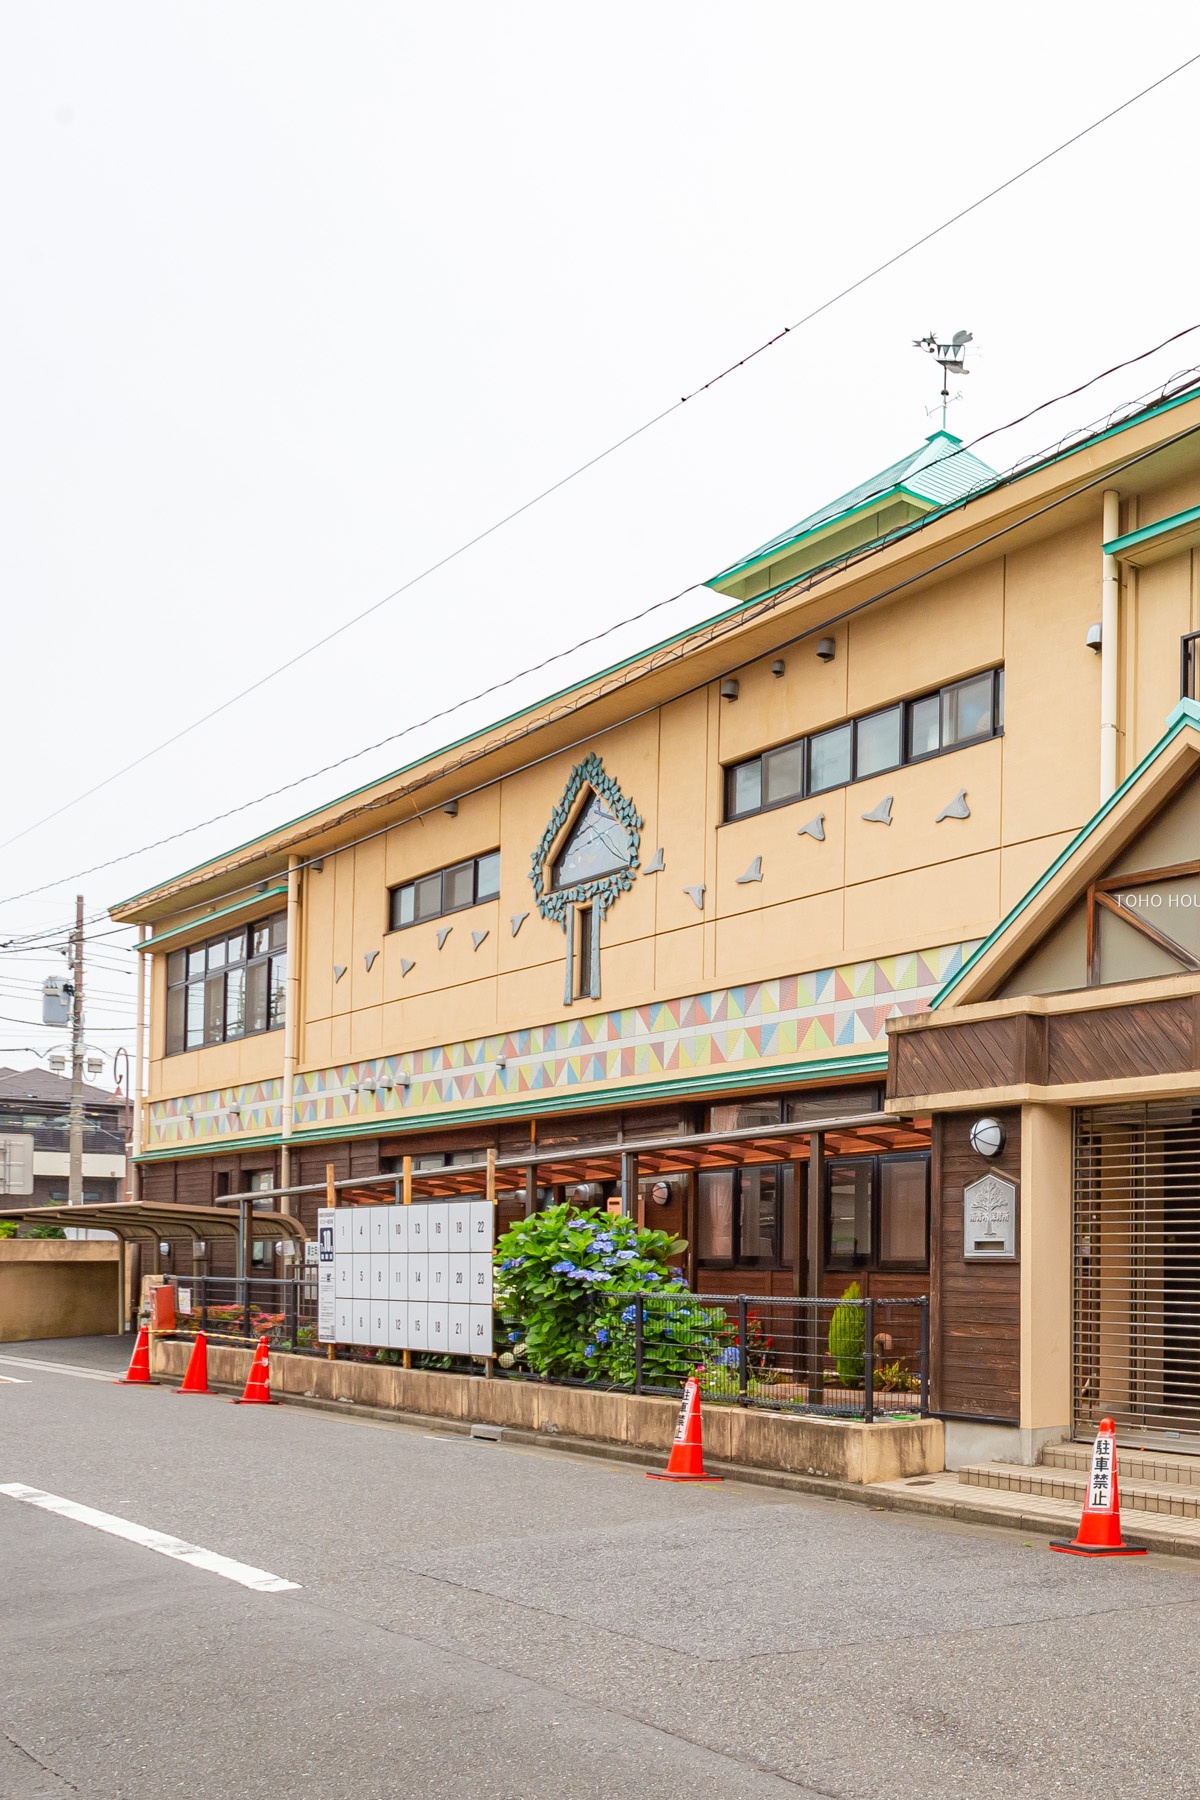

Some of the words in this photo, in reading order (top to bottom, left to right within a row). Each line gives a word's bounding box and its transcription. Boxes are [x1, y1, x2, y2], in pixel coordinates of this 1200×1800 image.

[359, 1225, 364, 1236] 4
[377, 1224, 382, 1236] 7
[394, 1223, 402, 1235] 10
[414, 1222, 421, 1235] 13
[434, 1222, 442, 1234] 16
[455, 1221, 463, 1234] 19
[477, 1220, 485, 1234] 22
[341, 1270, 346, 1282] 2
[359, 1270, 364, 1282] 5
[377, 1270, 382, 1283] 8
[395, 1271, 401, 1283] 11
[415, 1271, 421, 1283] 14
[435, 1271, 442, 1284] 17
[455, 1271, 463, 1285] 20
[477, 1272, 485, 1285] 23
[341, 1315, 346, 1327] 3
[359, 1316, 364, 1328] 6
[377, 1317, 382, 1329] 9
[395, 1318, 402, 1331] 12
[414, 1319, 421, 1332] 15
[434, 1320, 441, 1333] 18
[455, 1322, 462, 1335] 21
[476, 1323, 484, 1337] 24
[1091, 1439, 1110, 1507] 駐車禁止
